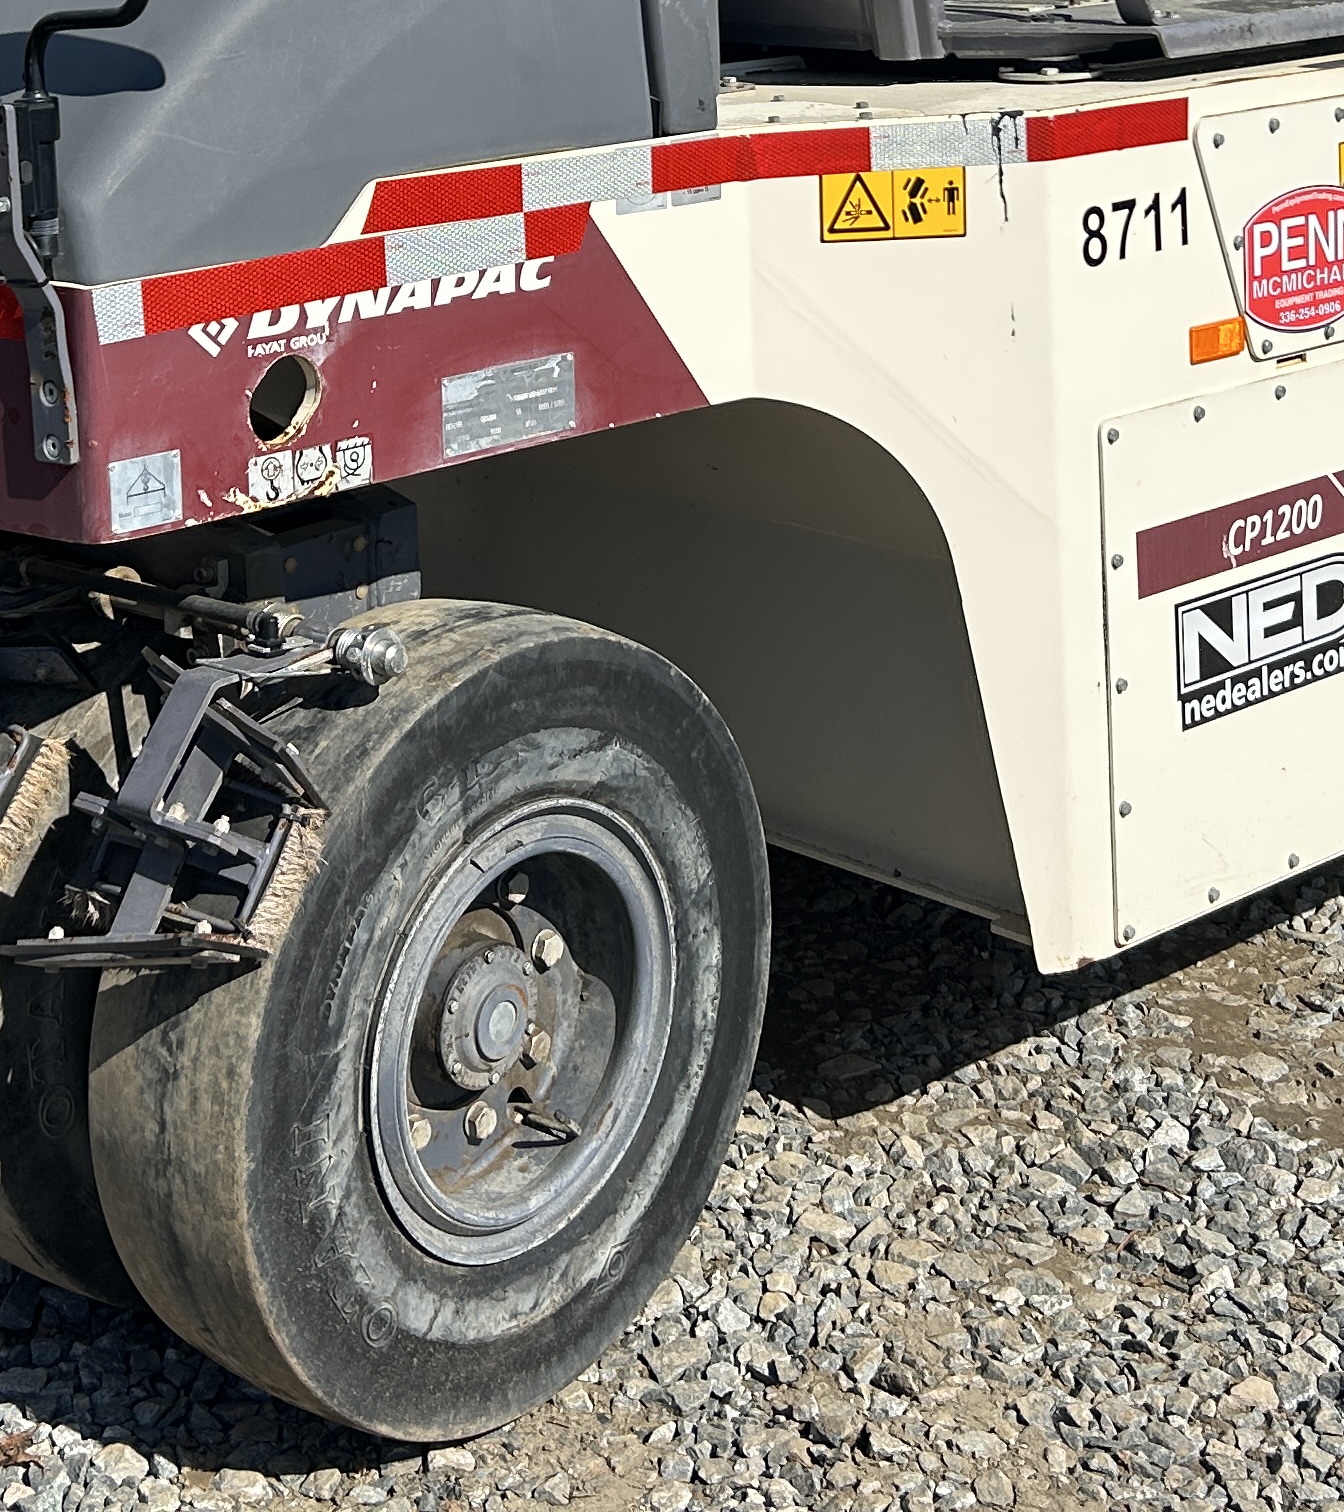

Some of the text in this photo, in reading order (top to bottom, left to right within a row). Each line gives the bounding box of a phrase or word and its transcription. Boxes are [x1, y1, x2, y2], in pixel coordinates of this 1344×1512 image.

[1082, 187, 1188, 267] 8711
[247, 256, 554, 339] DYNAPAC
[1275, 286, 1344, 309] EQUIPMENT TRADING
[1279, 300, 1341, 324] 336-254-0906
[290, 333, 327, 350] GROU
[1228, 493, 1323, 556] CP1200
